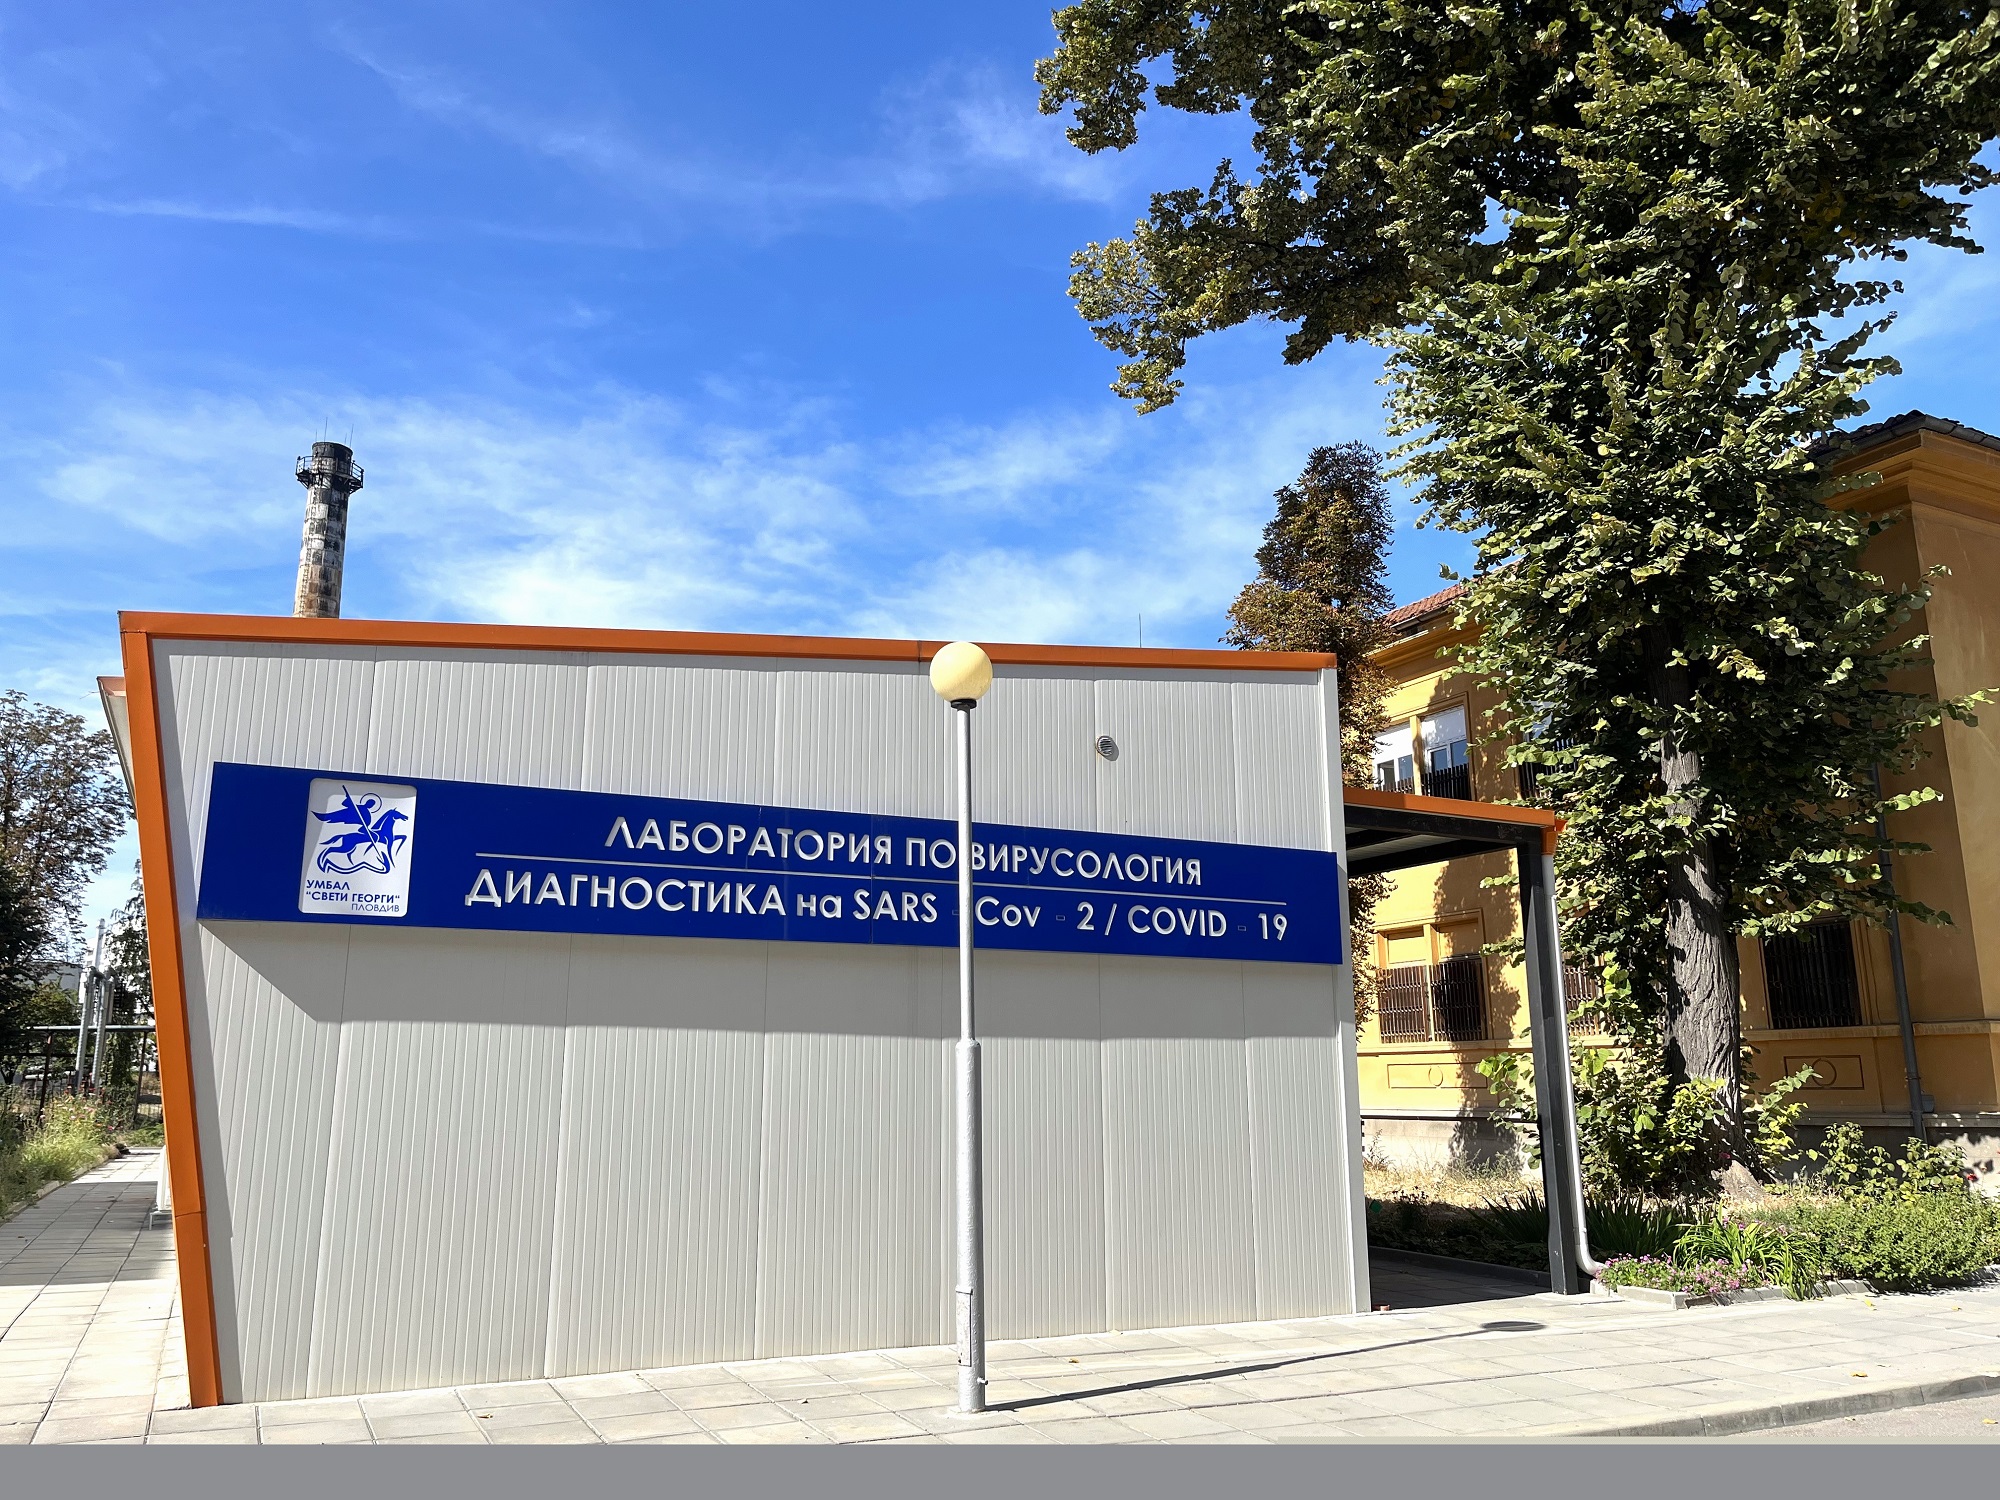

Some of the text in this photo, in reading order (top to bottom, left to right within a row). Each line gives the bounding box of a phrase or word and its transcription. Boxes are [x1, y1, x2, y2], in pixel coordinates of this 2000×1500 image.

[605, 816, 1202, 886] ЛАБОРАТОРИЯ ПО ВИРУСОЛОГИЯ
[306, 879, 350, 891] УМБАЛ
[465, 868, 786, 916] ДИАГНОСТИКА
[796, 893, 842, 919] на
[853, 889, 938, 923] SARS
[975, 896, 1041, 928] Cov
[1077, 902, 1095, 931] 2
[1105, 904, 1118, 936] /
[1128, 905, 1227, 937] COVID
[1258, 913, 1288, 941] 19
[351, 903, 399, 913] ПЛОВДИВ
